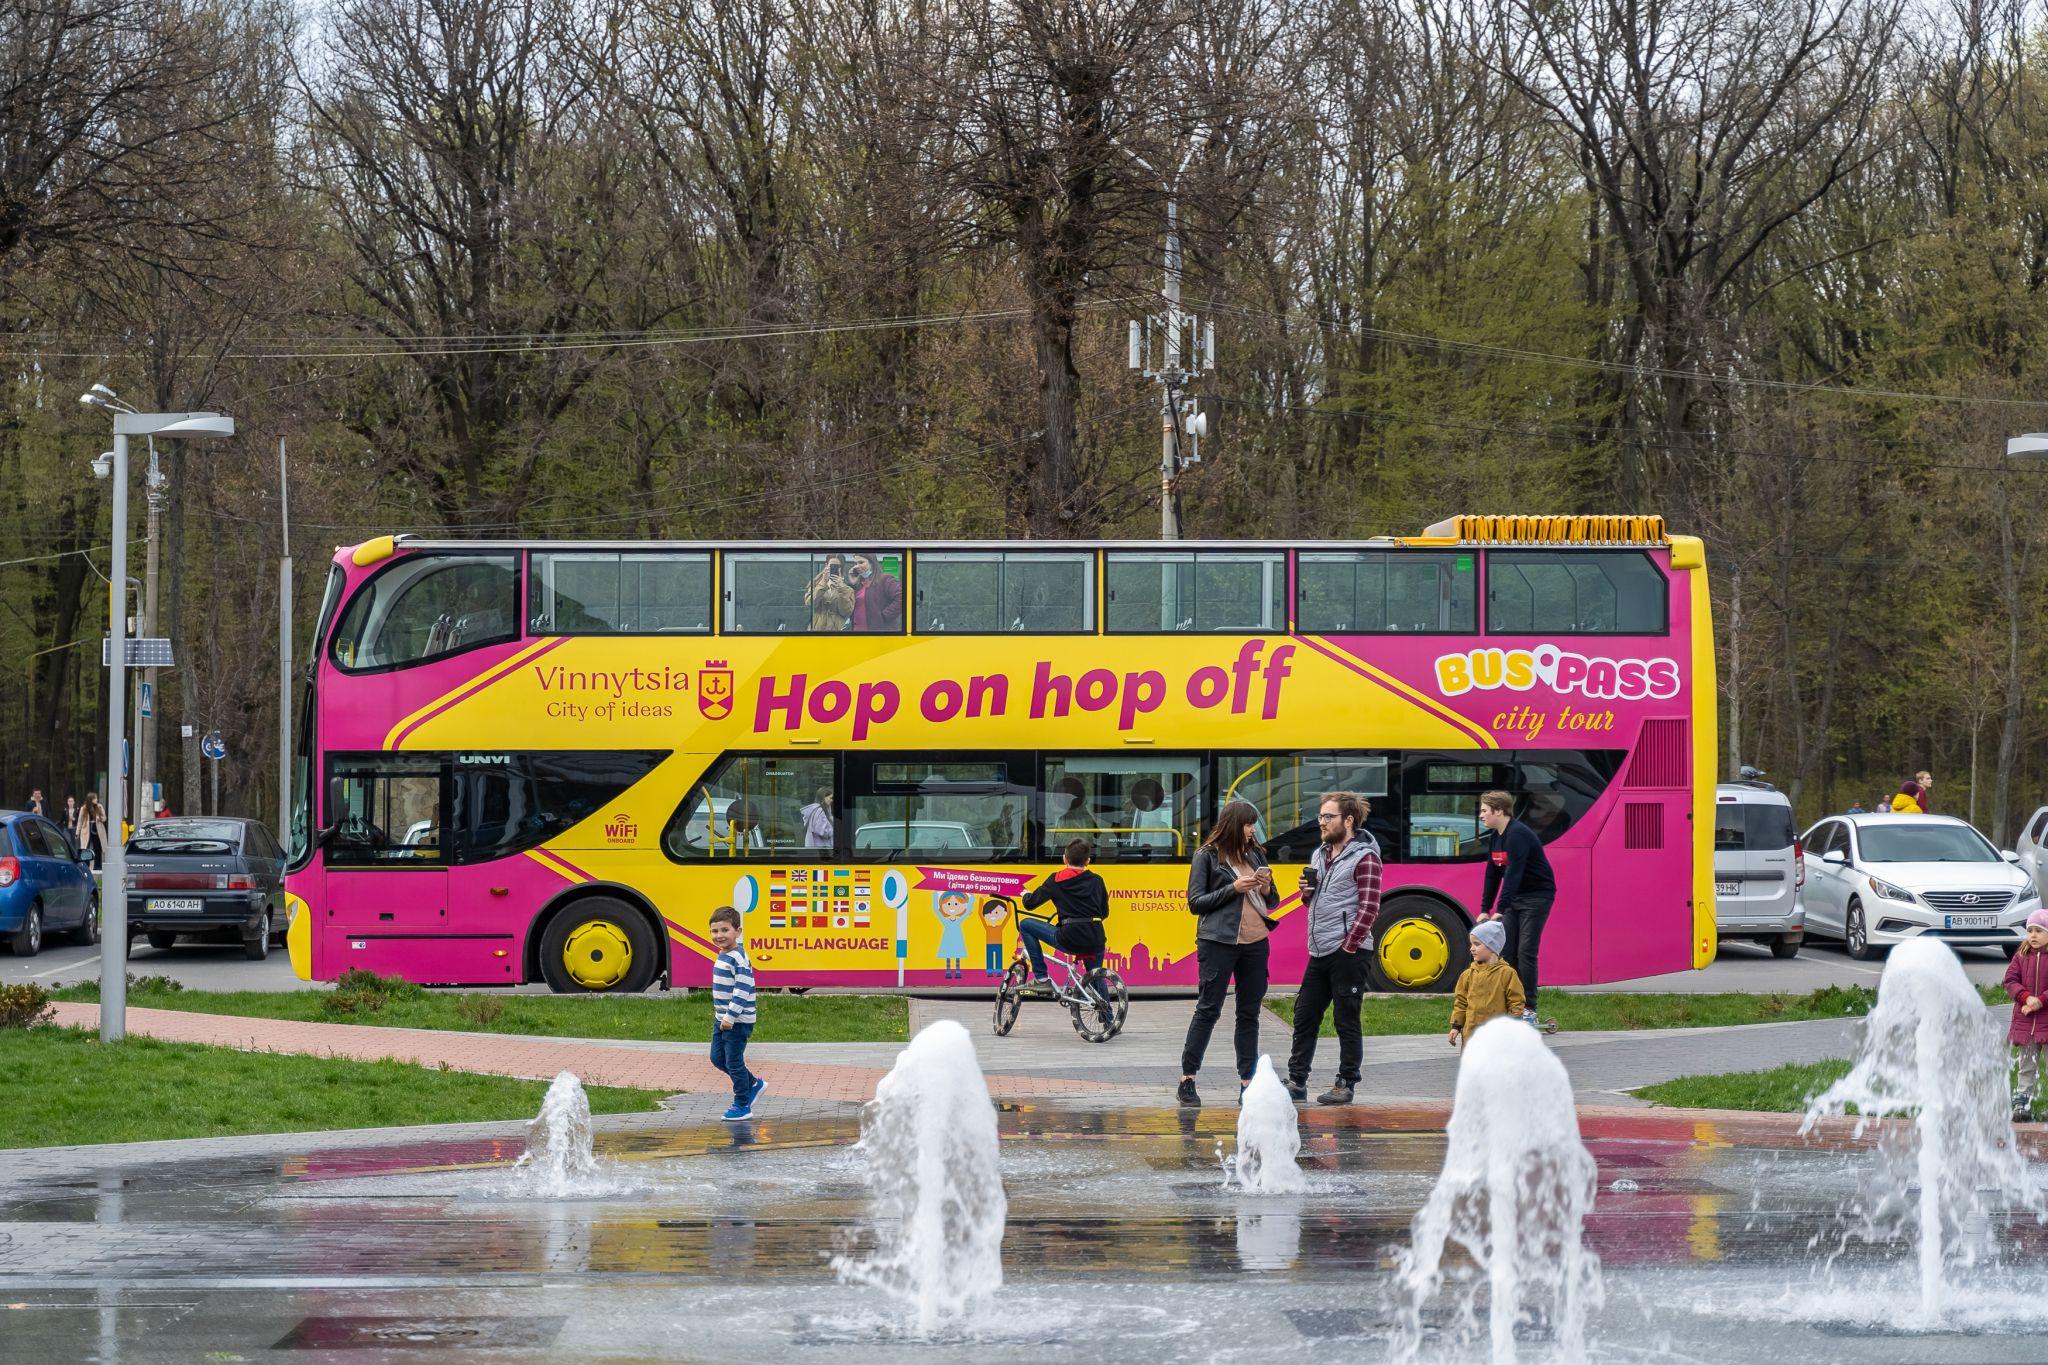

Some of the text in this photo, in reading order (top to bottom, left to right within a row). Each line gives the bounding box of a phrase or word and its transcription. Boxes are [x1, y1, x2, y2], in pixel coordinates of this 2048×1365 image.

[1436, 648, 1680, 700] BUS PASS
[535, 666, 689, 698] Vinnytsia
[753, 639, 1296, 741] Hop on hop off
[546, 701, 673, 721] City of ideas
[1492, 706, 1614, 741] city tour
[460, 756, 510, 764] UNVI
[605, 824, 637, 837] WiFi
[947, 873, 968, 881] їдемо
[970, 874, 1019, 884] безкоштовно
[1726, 884, 1738, 892] HK
[167, 900, 185, 909] 6140
[187, 900, 199, 909] AH
[1952, 917, 1994, 926] AB 9001 HT
[750, 937, 889, 951] MULTI-LANGUAGE
